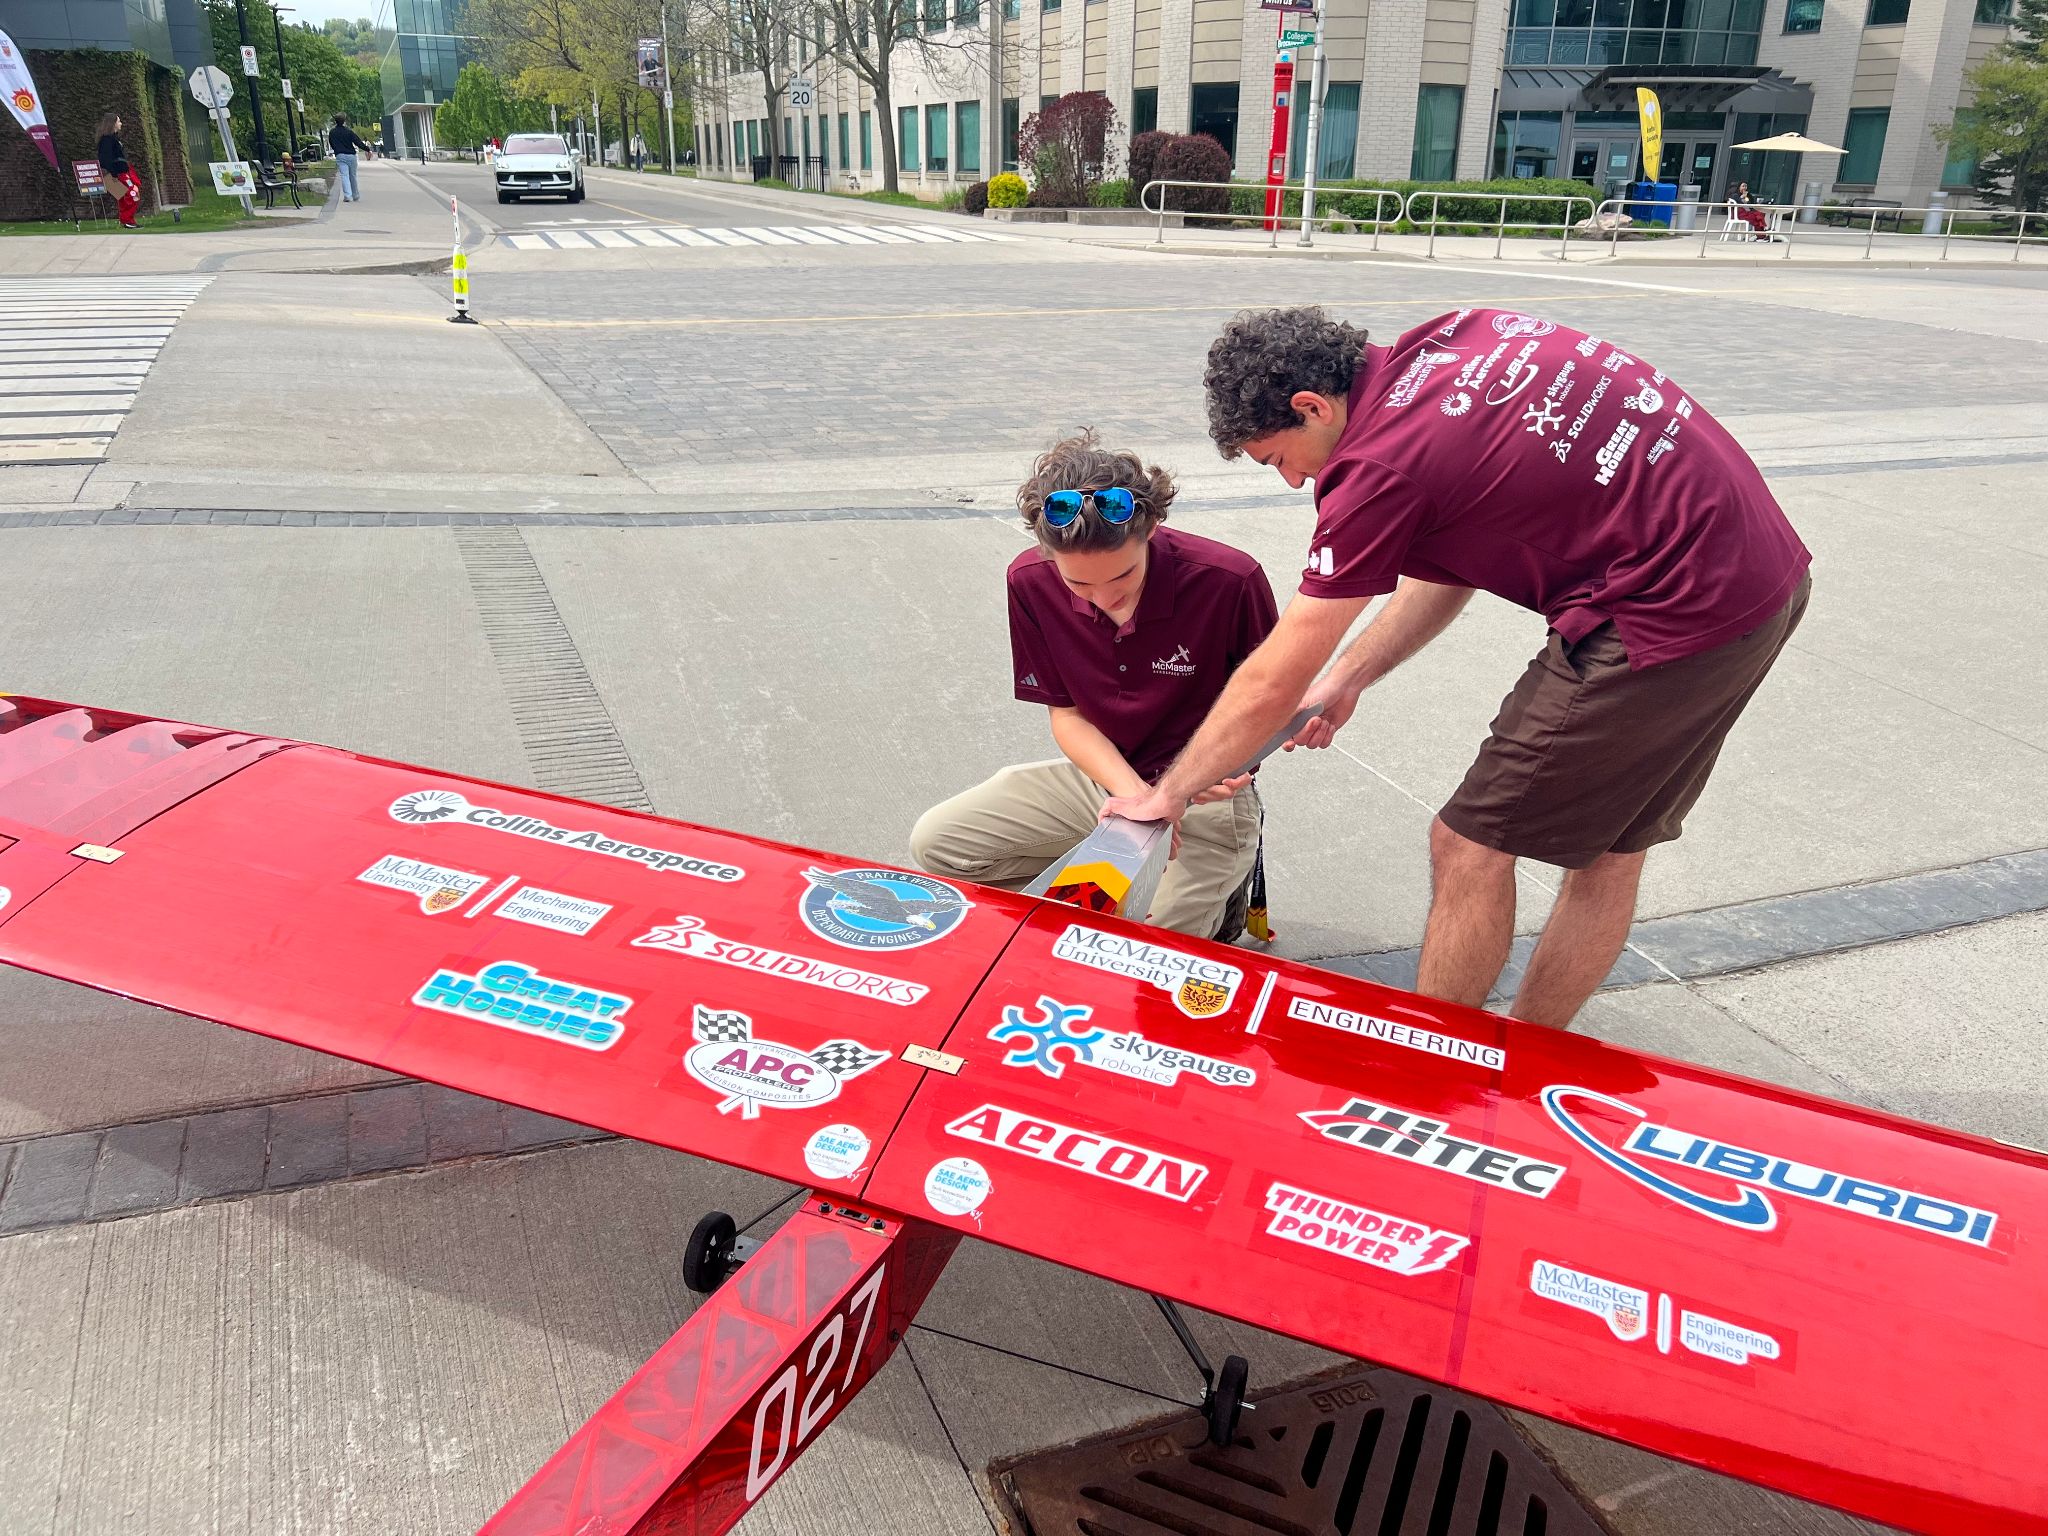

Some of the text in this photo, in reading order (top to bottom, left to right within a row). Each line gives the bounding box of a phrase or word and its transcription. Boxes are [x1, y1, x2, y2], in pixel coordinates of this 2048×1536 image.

[1287, 32, 1307, 41] College
[792, 91, 810, 104] 20
[1385, 348, 1430, 408] McMaster
[1399, 363, 1436, 407] University
[1454, 354, 1484, 387] Collins
[1547, 360, 1576, 397] skygauge
[1559, 380, 1575, 401] robotics
[1567, 375, 1612, 439] SOLIDWORKS
[1594, 424, 1640, 486] HOBBIES
[1596, 418, 1631, 465] GREAT
[1152, 661, 1196, 672] McMaster
[466, 809, 738, 880] Collins Aerospace
[363, 869, 437, 894] University
[375, 857, 481, 890] McMaster
[855, 872, 896, 880] PRATT
[911, 877, 954, 897] WHITNEY
[502, 902, 590, 932] Engineering
[517, 889, 607, 916] Mechanical
[812, 910, 922, 945] DEPENDABLE ENGINES
[704, 941, 924, 1003] SOLIDWORKS
[1056, 943, 1176, 987] University
[1062, 927, 1238, 985] McMaster
[421, 974, 616, 1042] HOBBIES
[481, 965, 625, 1016] GREAT
[752, 1045, 797, 1059] ADVANCED
[1294, 1001, 1500, 1067] ENGINEERING
[716, 1048, 815, 1086] APC
[1100, 1055, 1174, 1085] robotics
[1110, 1035, 1251, 1085] skygauge
[700, 1066, 811, 1100] PRECISION COMPOSITES
[713, 1065, 803, 1092] PROPELLERS
[815, 1141, 848, 1156] DESIGN
[818, 1135, 836, 1145] SAE
[836, 1140, 861, 1151] AERO
[935, 1175, 969, 1191] DESIGN
[938, 1168, 956, 1179] SAE
[957, 1175, 982, 1187] AERO
[1631, 1126, 1993, 1243] LIBURDI
[1273, 1189, 1425, 1246] THUNDER
[1275, 1215, 1400, 1264] POWER
[1536, 1281, 1610, 1313] University
[1537, 1264, 1642, 1308] McMaster
[1685, 1332, 1743, 1360] Physics
[1686, 1314, 1773, 1354] Engineering
[746, 1262, 885, 1501] 027
